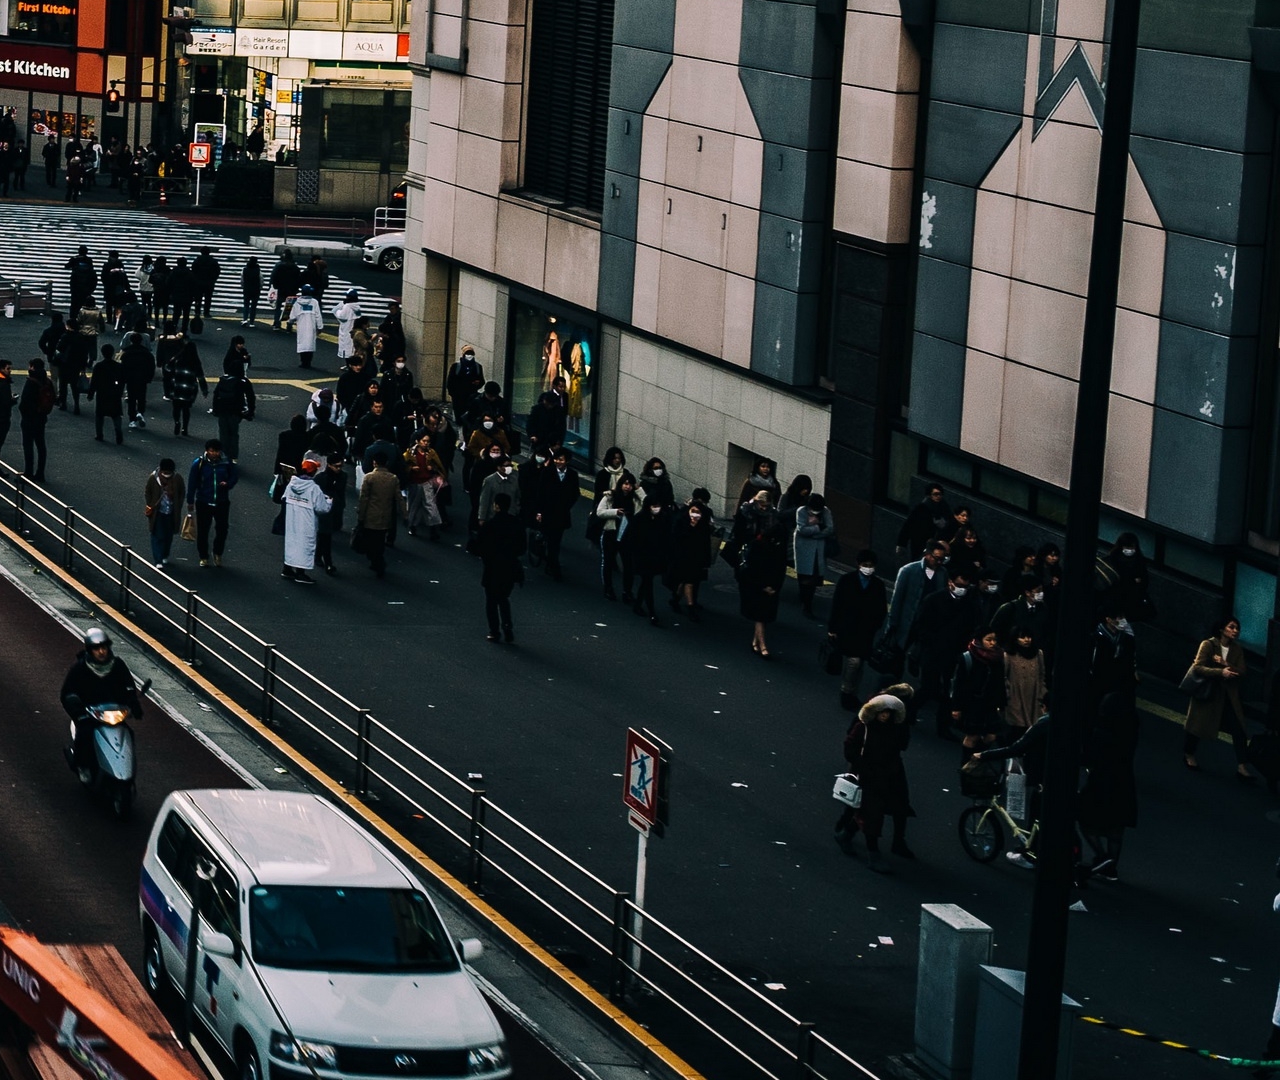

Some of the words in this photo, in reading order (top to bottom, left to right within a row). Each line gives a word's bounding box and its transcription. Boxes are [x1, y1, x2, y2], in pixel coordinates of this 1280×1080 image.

[18, 2, 40, 12] First
[253, 35, 266, 43] Hair
[267, 35, 287, 43] Resort
[253, 43, 287, 52] Garden
[354, 40, 385, 53] AQUA
[13, 59, 70, 79] Kitchen
[2, 949, 40, 1003] UNIC
